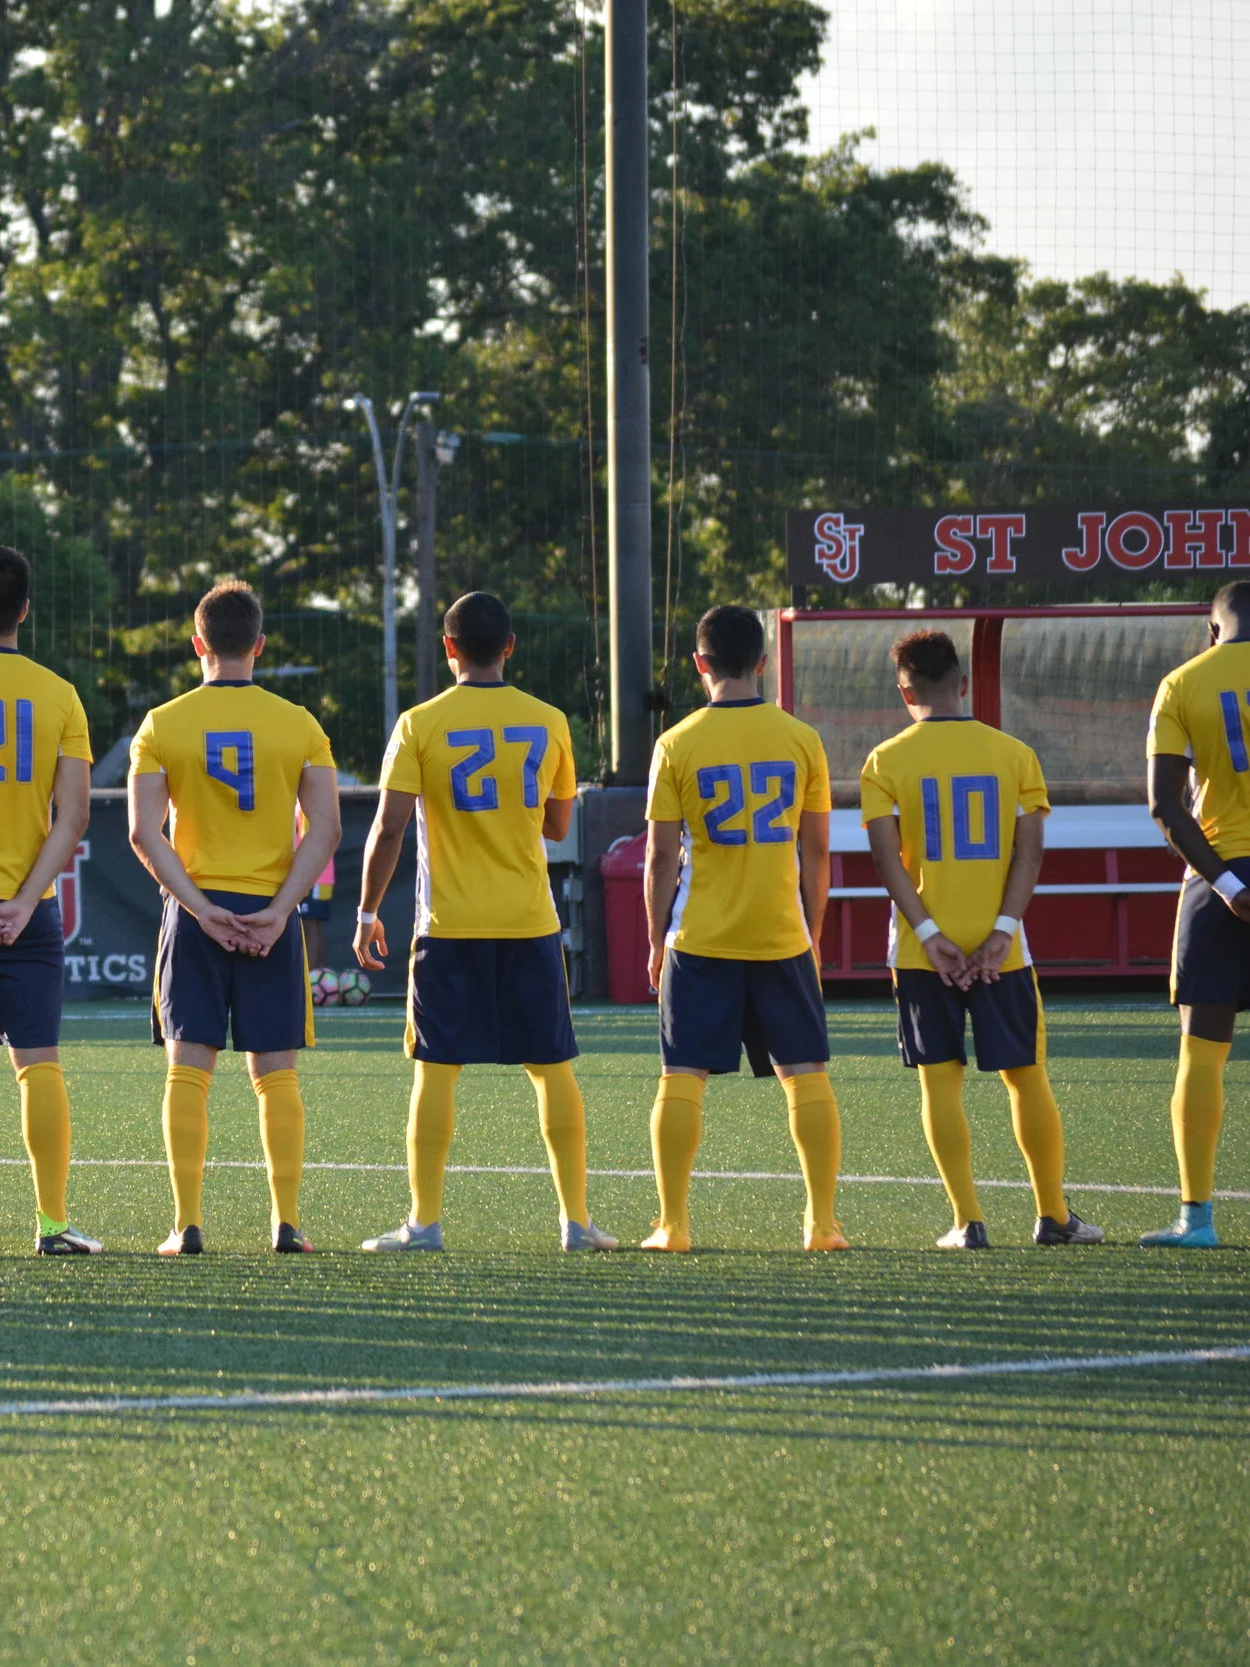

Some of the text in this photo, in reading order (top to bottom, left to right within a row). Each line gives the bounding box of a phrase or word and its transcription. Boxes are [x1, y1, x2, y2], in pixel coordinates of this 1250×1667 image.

[814, 512, 864, 583] SJ
[934, 514, 1026, 574] ST
[204, 730, 255, 811] 9
[447, 725, 549, 812] 27
[1219, 690, 1250, 772] 1
[696, 761, 797, 845] 22
[921, 775, 999, 860] 10
[65, 954, 147, 982] TICS
